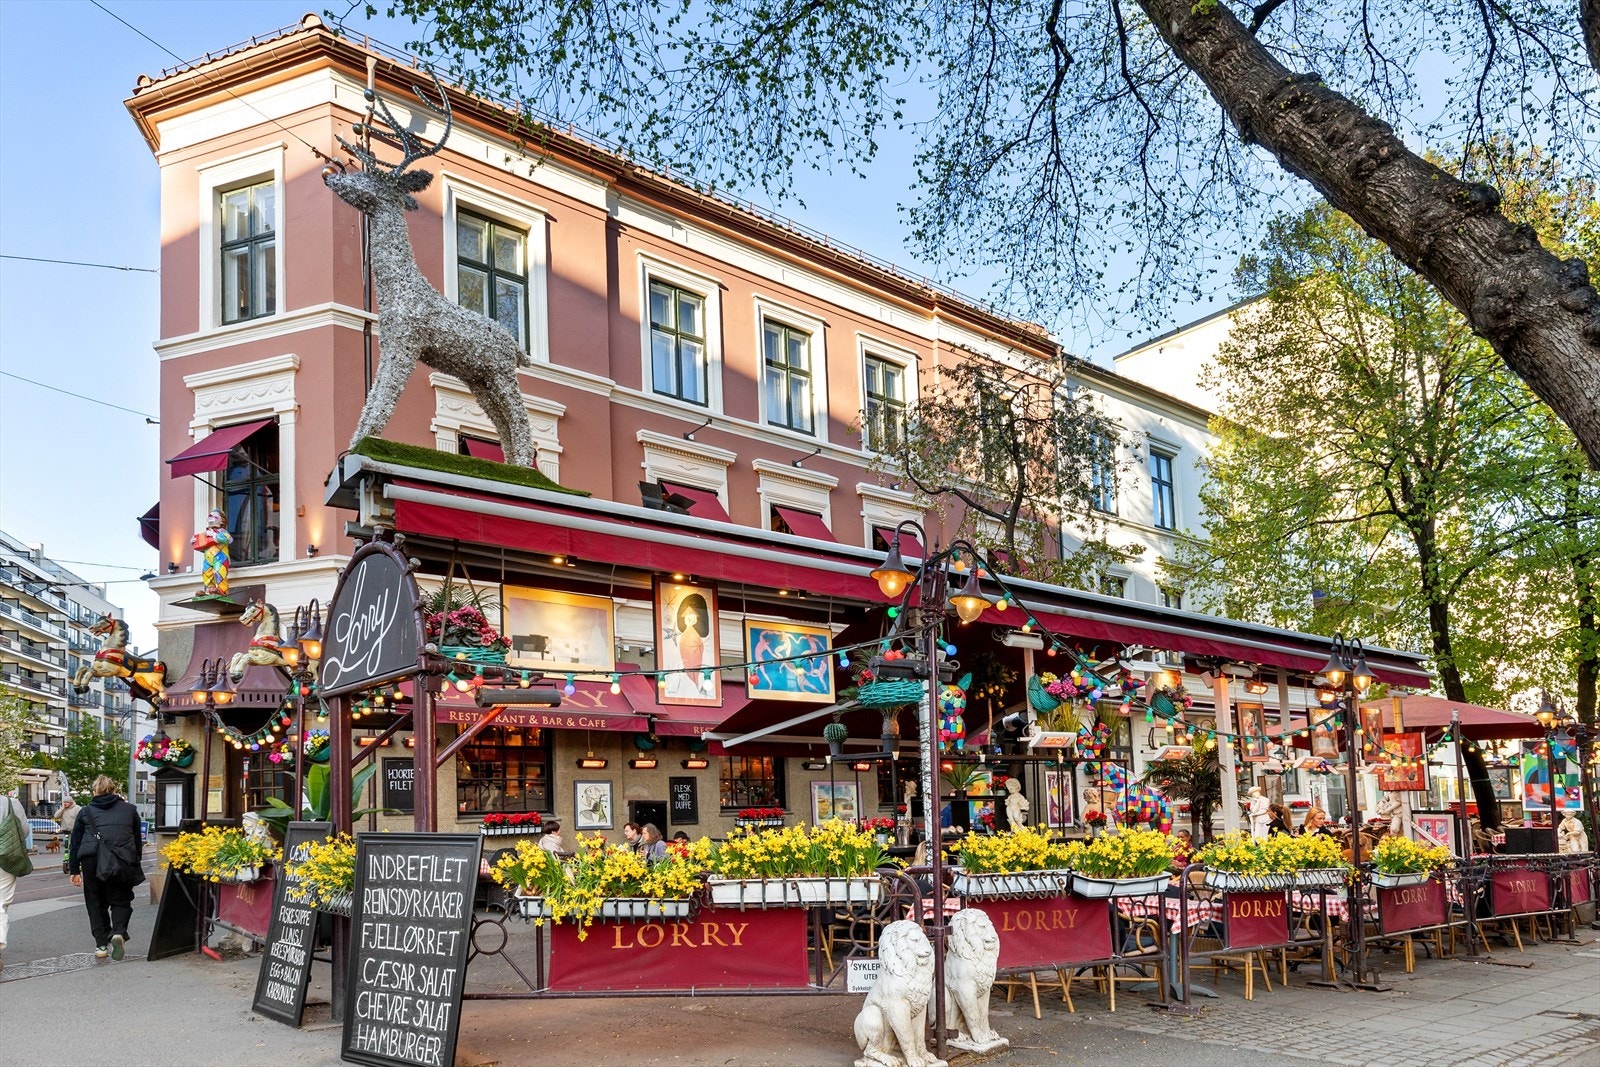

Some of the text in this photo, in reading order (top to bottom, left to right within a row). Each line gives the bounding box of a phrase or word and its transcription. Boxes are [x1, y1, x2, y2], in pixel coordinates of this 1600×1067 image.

[322, 560, 402, 690] Lorry
[449, 711, 526, 725] RESTARANT
[529, 715, 539, 726] &
[542, 716, 563, 726] BAR
[566, 717, 576, 728] &
[389, 780, 414, 791] FILET
[674, 784, 692, 794] FLESK
[677, 793, 691, 802] MED
[368, 854, 469, 883] INDREFILET
[1231, 899, 1284, 918] LORRY
[1393, 887, 1428, 906] LORRY
[278, 905, 312, 926] FISKESUPPE
[1001, 908, 1079, 932] LORRY
[280, 926, 304, 946] LUNSJ
[361, 922, 460, 957] FJELLØRRET
[611, 922, 749, 949] LORRY
[362, 957, 457, 998] CÆSAR SALAT
[265, 980, 297, 1006] KARBONADE
[356, 991, 452, 1031] CHEVRE SALAT
[357, 1023, 442, 1066] HAMBURGER
